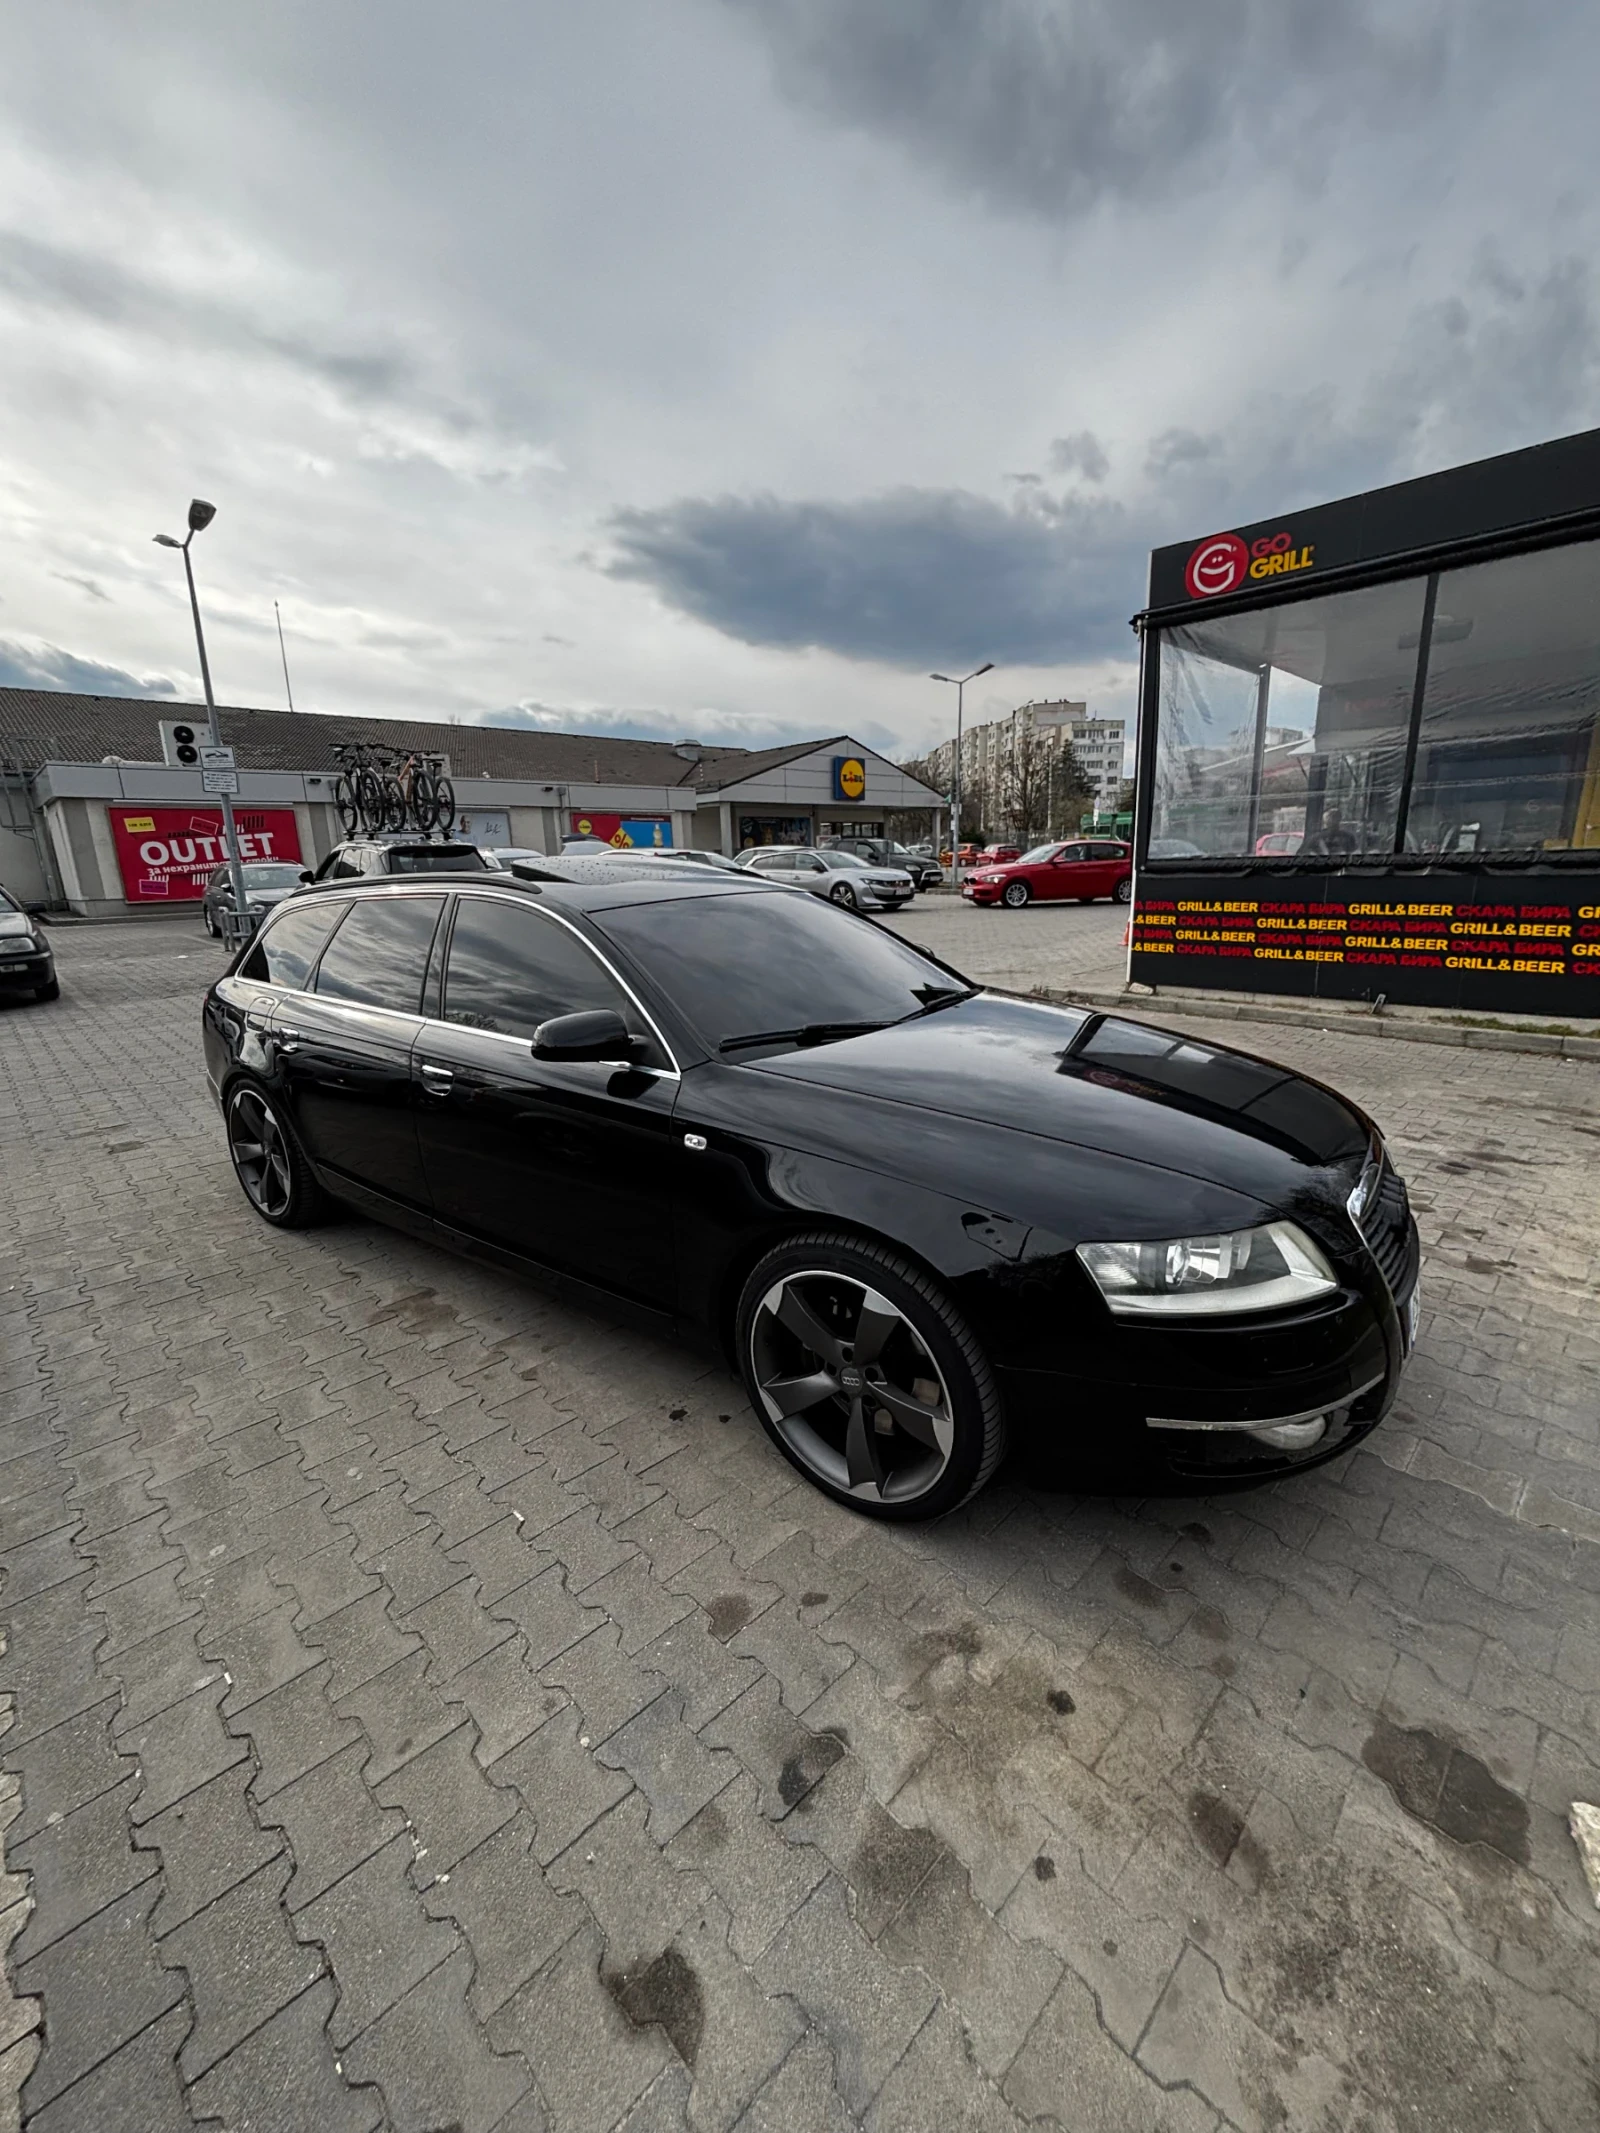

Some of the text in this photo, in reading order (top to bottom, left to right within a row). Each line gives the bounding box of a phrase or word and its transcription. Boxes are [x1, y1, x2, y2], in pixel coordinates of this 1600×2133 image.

[1251, 532, 1292, 558] GO
[1249, 546, 1313, 578] GRILL
[140, 832, 274, 866] OUTLET
[147, 867, 161, 876] за
[1146, 901, 1176, 911] БИРА
[1260, 902, 1305, 914] СКАРА
[1308, 902, 1346, 914] БИРА
[1456, 904, 1516, 917] СКАРА
[1520, 906, 1572, 918] БИРА
[1178, 916, 1219, 926] СКАРА
[1222, 917, 1255, 928] БИРА
[1349, 919, 1402, 932] СКАРА
[1404, 921, 1447, 934] БИРА
[1144, 929, 1172, 940] БИРА
[1258, 932, 1302, 944] СКАРА
[1306, 934, 1342, 946] БИРА
[1451, 940, 1510, 954] СКАРА
[1514, 942, 1564, 956] БИРА
[1176, 944, 1217, 955] СКАРА
[1219, 946, 1252, 958] БИРА
[1346, 952, 1397, 965] СКАРА
[1400, 954, 1442, 968] БИРА
